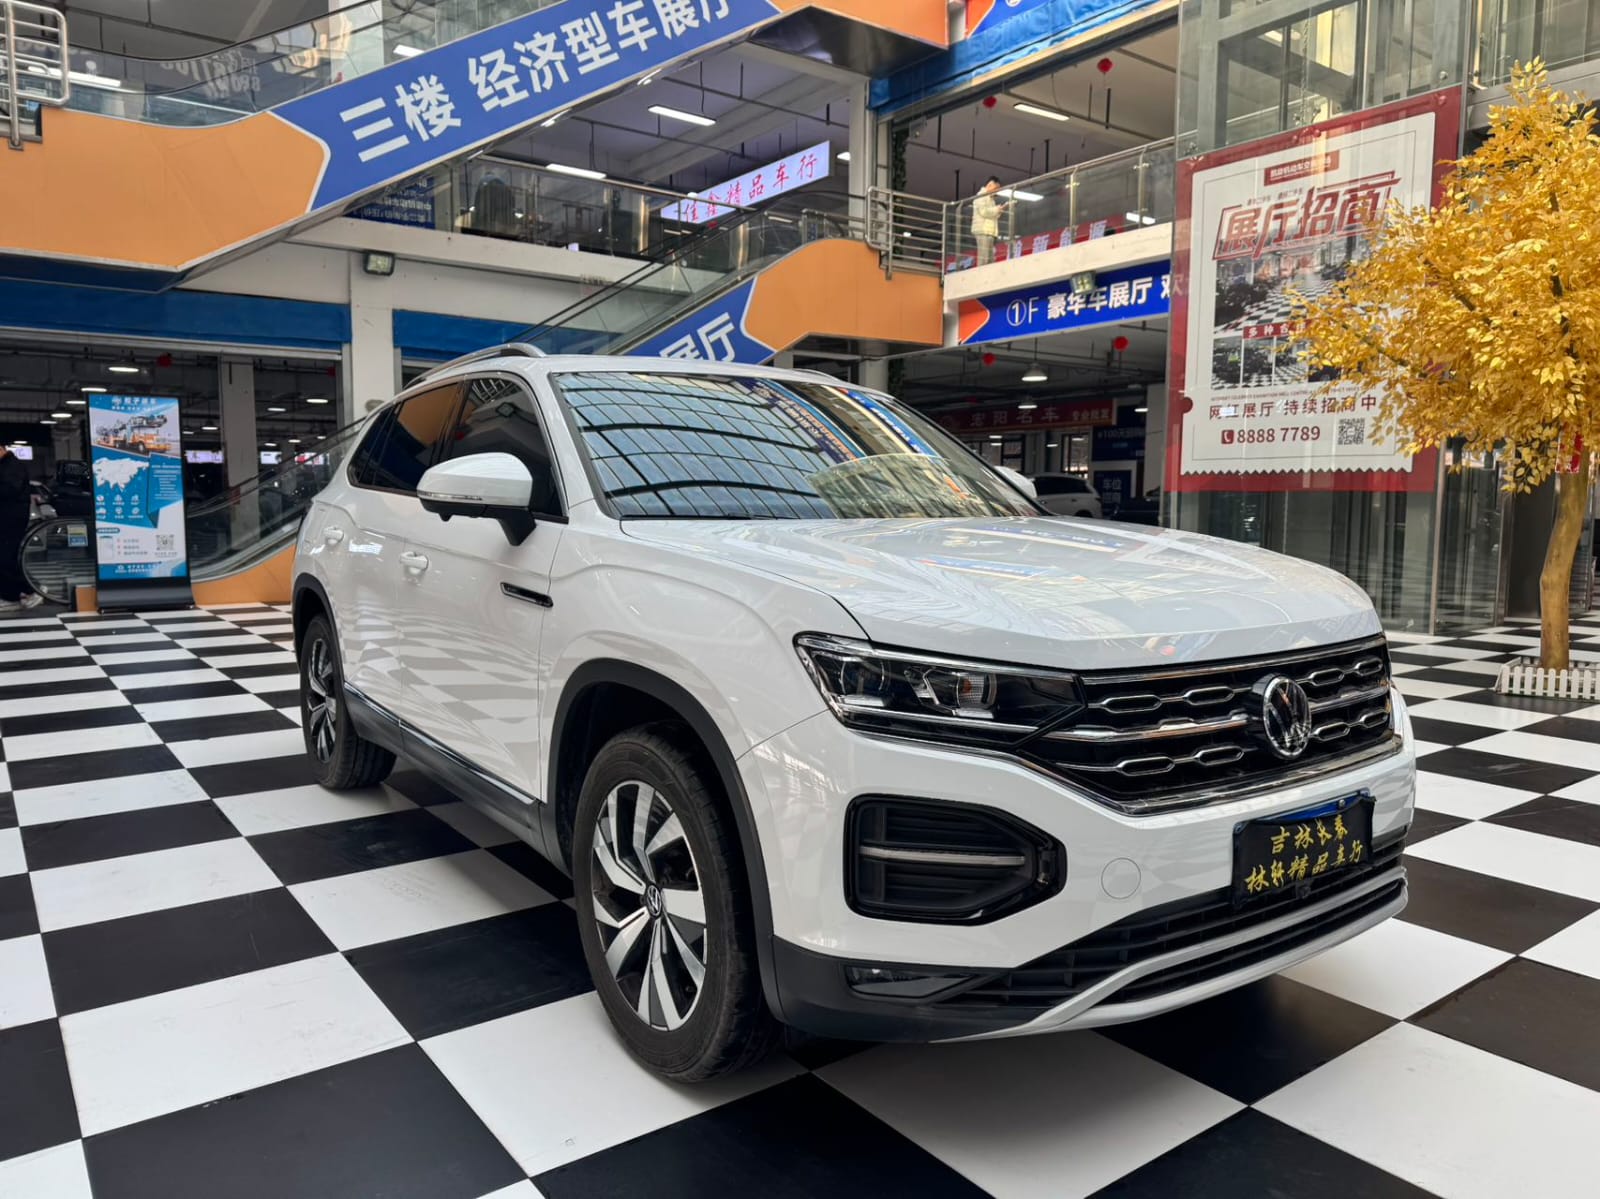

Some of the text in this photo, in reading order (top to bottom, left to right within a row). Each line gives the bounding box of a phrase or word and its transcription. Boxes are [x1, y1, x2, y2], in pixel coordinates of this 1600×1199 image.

[339, 74, 462, 163] 三楼
[1222, 178, 1400, 260] 展厅招商
[1048, 278, 1152, 320] 豪华车展厅
[1237, 426, 1321, 443] 8888 7789
